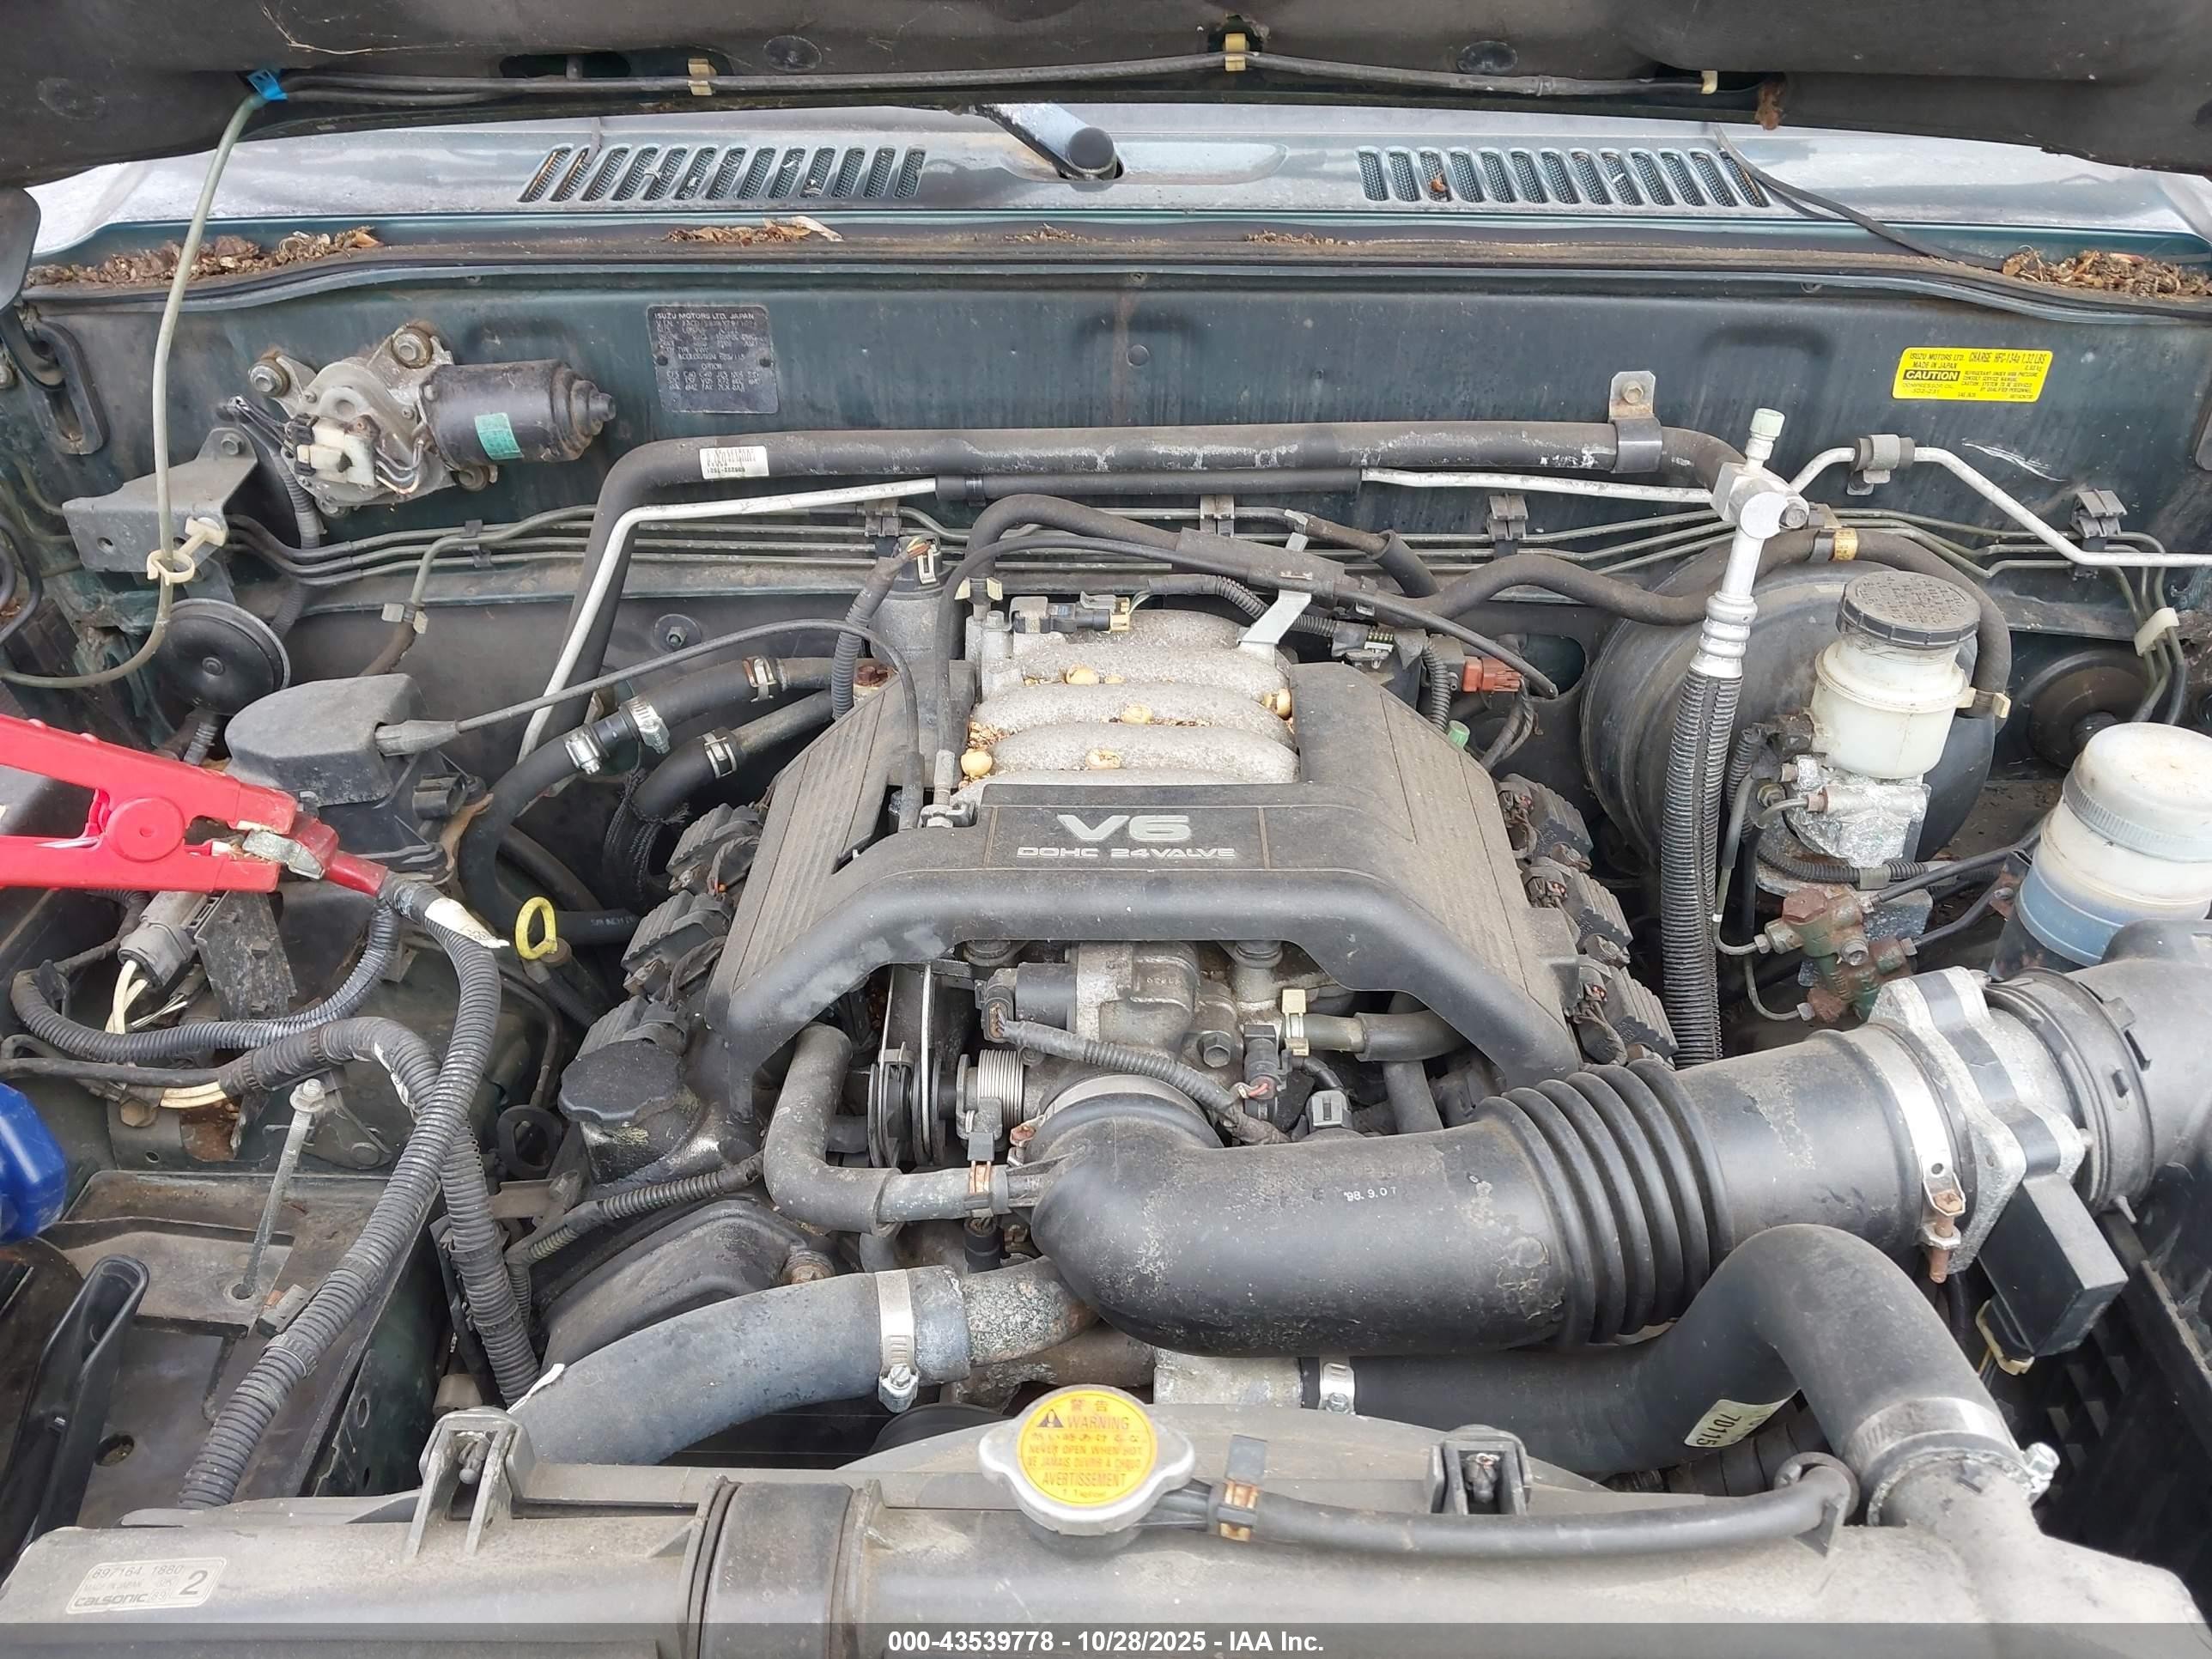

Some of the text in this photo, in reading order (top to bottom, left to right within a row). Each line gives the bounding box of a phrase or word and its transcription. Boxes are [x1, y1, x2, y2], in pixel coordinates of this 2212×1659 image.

[1969, 352, 1992, 362] CHARGE
[2034, 354, 2047, 364] LBS
[1905, 371, 1958, 380] CAUTION
[1057, 814, 1192, 842] V6
[1017, 847, 1098, 858] DOHC
[1066, 1415, 1130, 1430] WARNING
[1696, 1413, 1741, 1446] 70115
[1030, 1444, 1143, 1456] NEVER OPEN WHEN HOT
[1028, 1456, 1037, 1467] NE
[1041, 1457, 1071, 1468] JAMAIS
[1042, 1472, 1127, 1486] AVERTISSEMENT
[151, 1565, 183, 1576] 1880
[118, 1579, 143, 1588] JAPAN
[179, 1570, 209, 1595] 2
